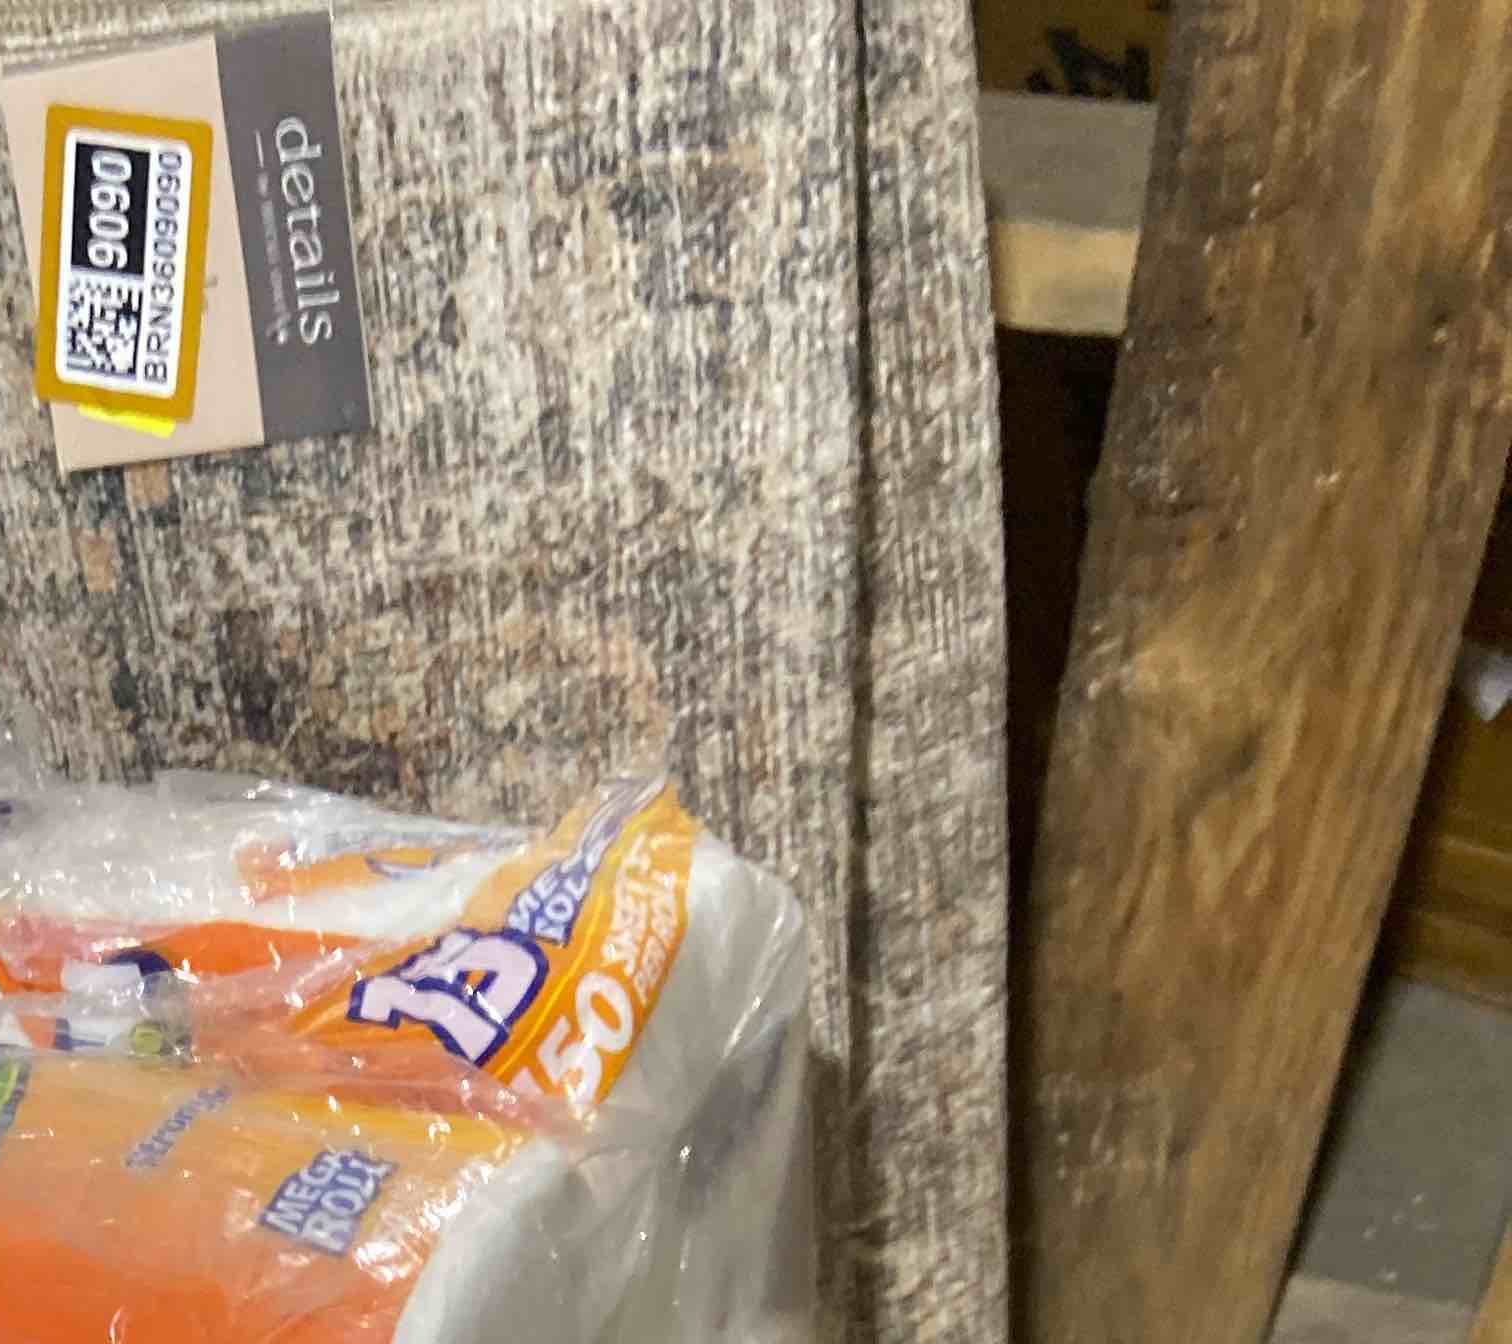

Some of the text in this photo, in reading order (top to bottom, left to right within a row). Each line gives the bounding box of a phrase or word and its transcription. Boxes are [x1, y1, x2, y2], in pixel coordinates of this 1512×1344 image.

[87, 148, 133, 271] 9090
[144, 150, 184, 383] BRN3609090
[274, 115, 341, 347] details
